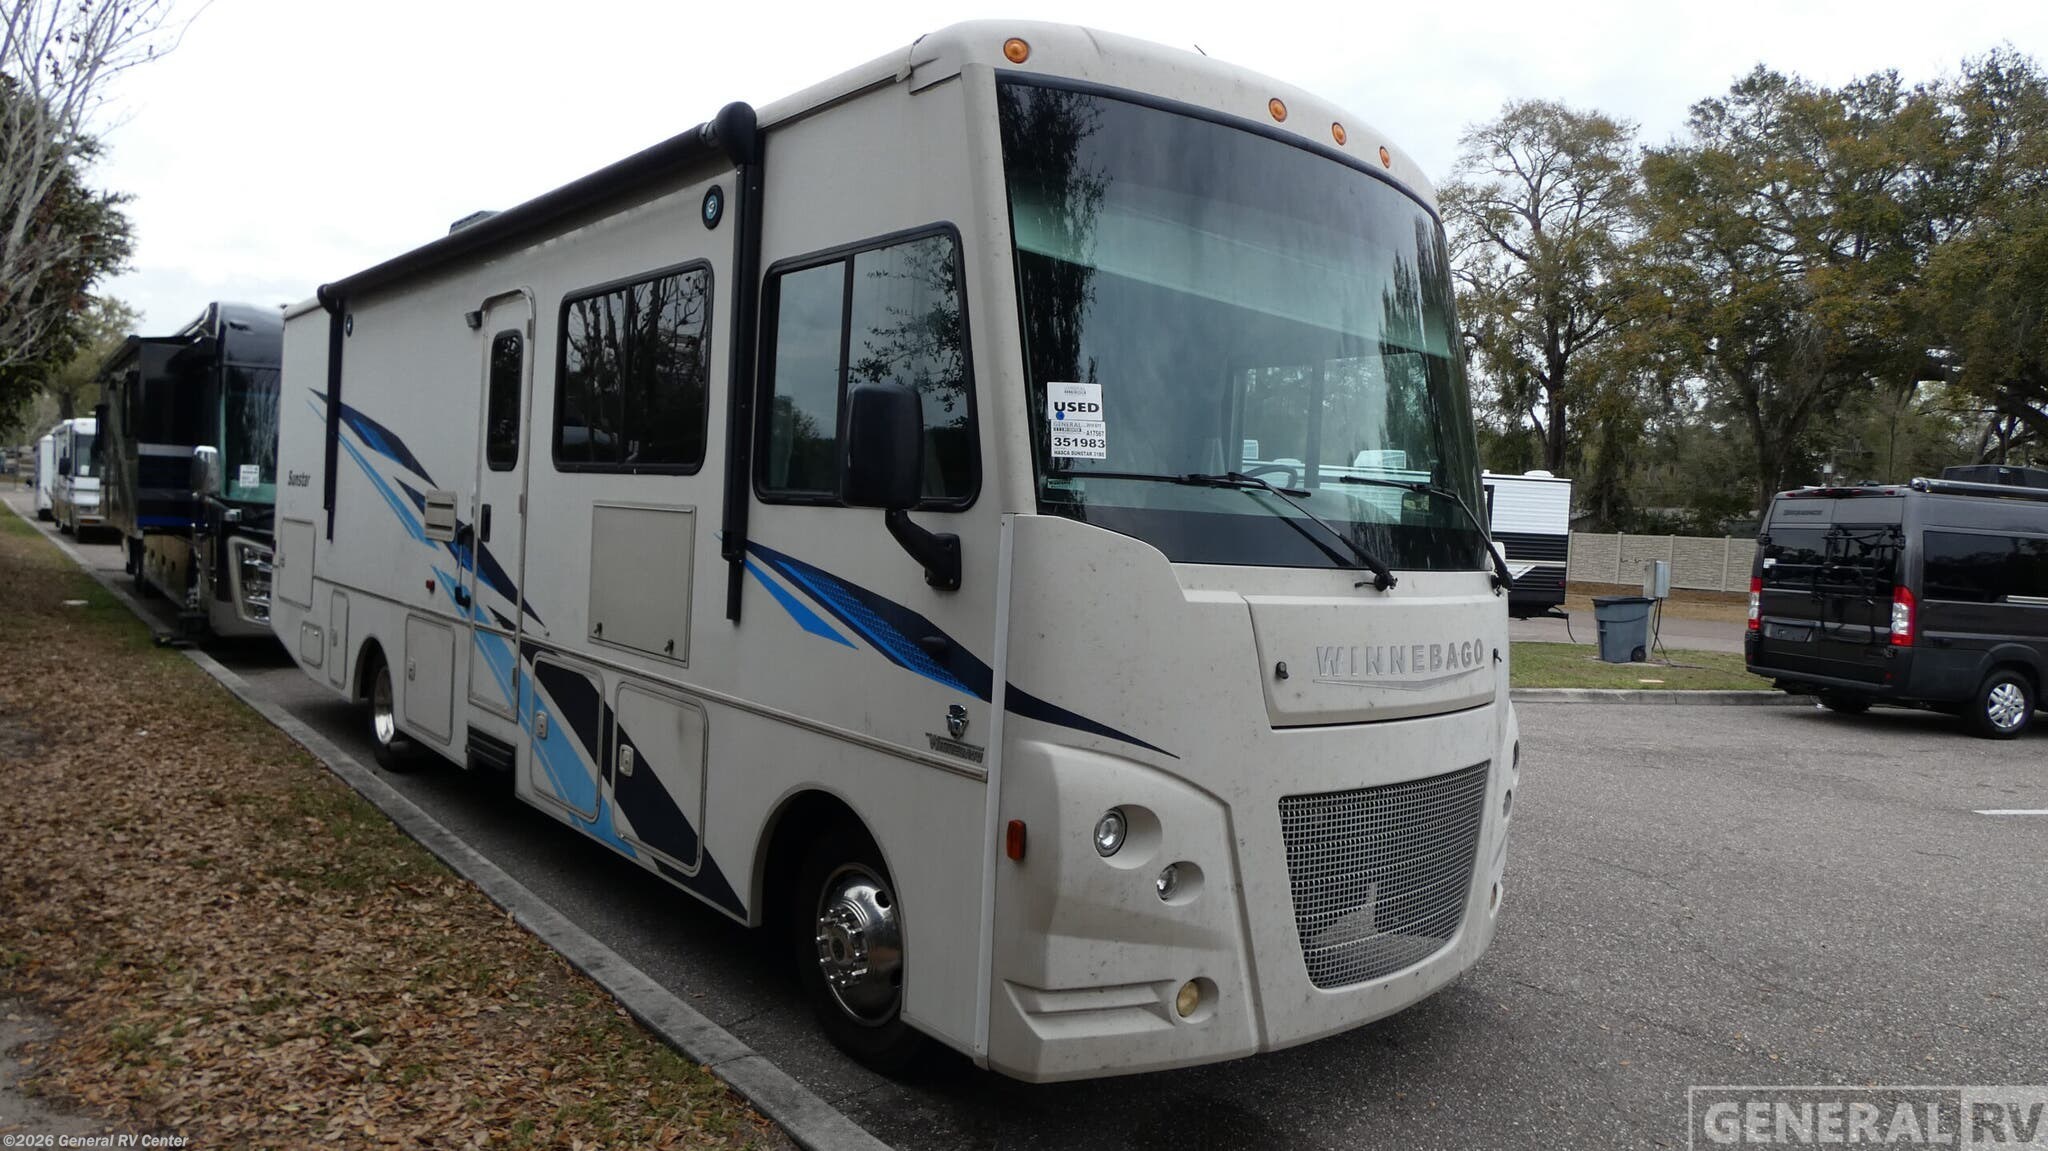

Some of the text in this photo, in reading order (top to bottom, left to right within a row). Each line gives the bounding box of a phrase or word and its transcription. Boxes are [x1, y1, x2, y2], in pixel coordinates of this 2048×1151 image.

[1054, 402, 1100, 413] USED
[1054, 437, 1106, 449] 351983
[288, 469, 311, 488] Sunstar
[1316, 638, 1484, 677] WINNEBAGO
